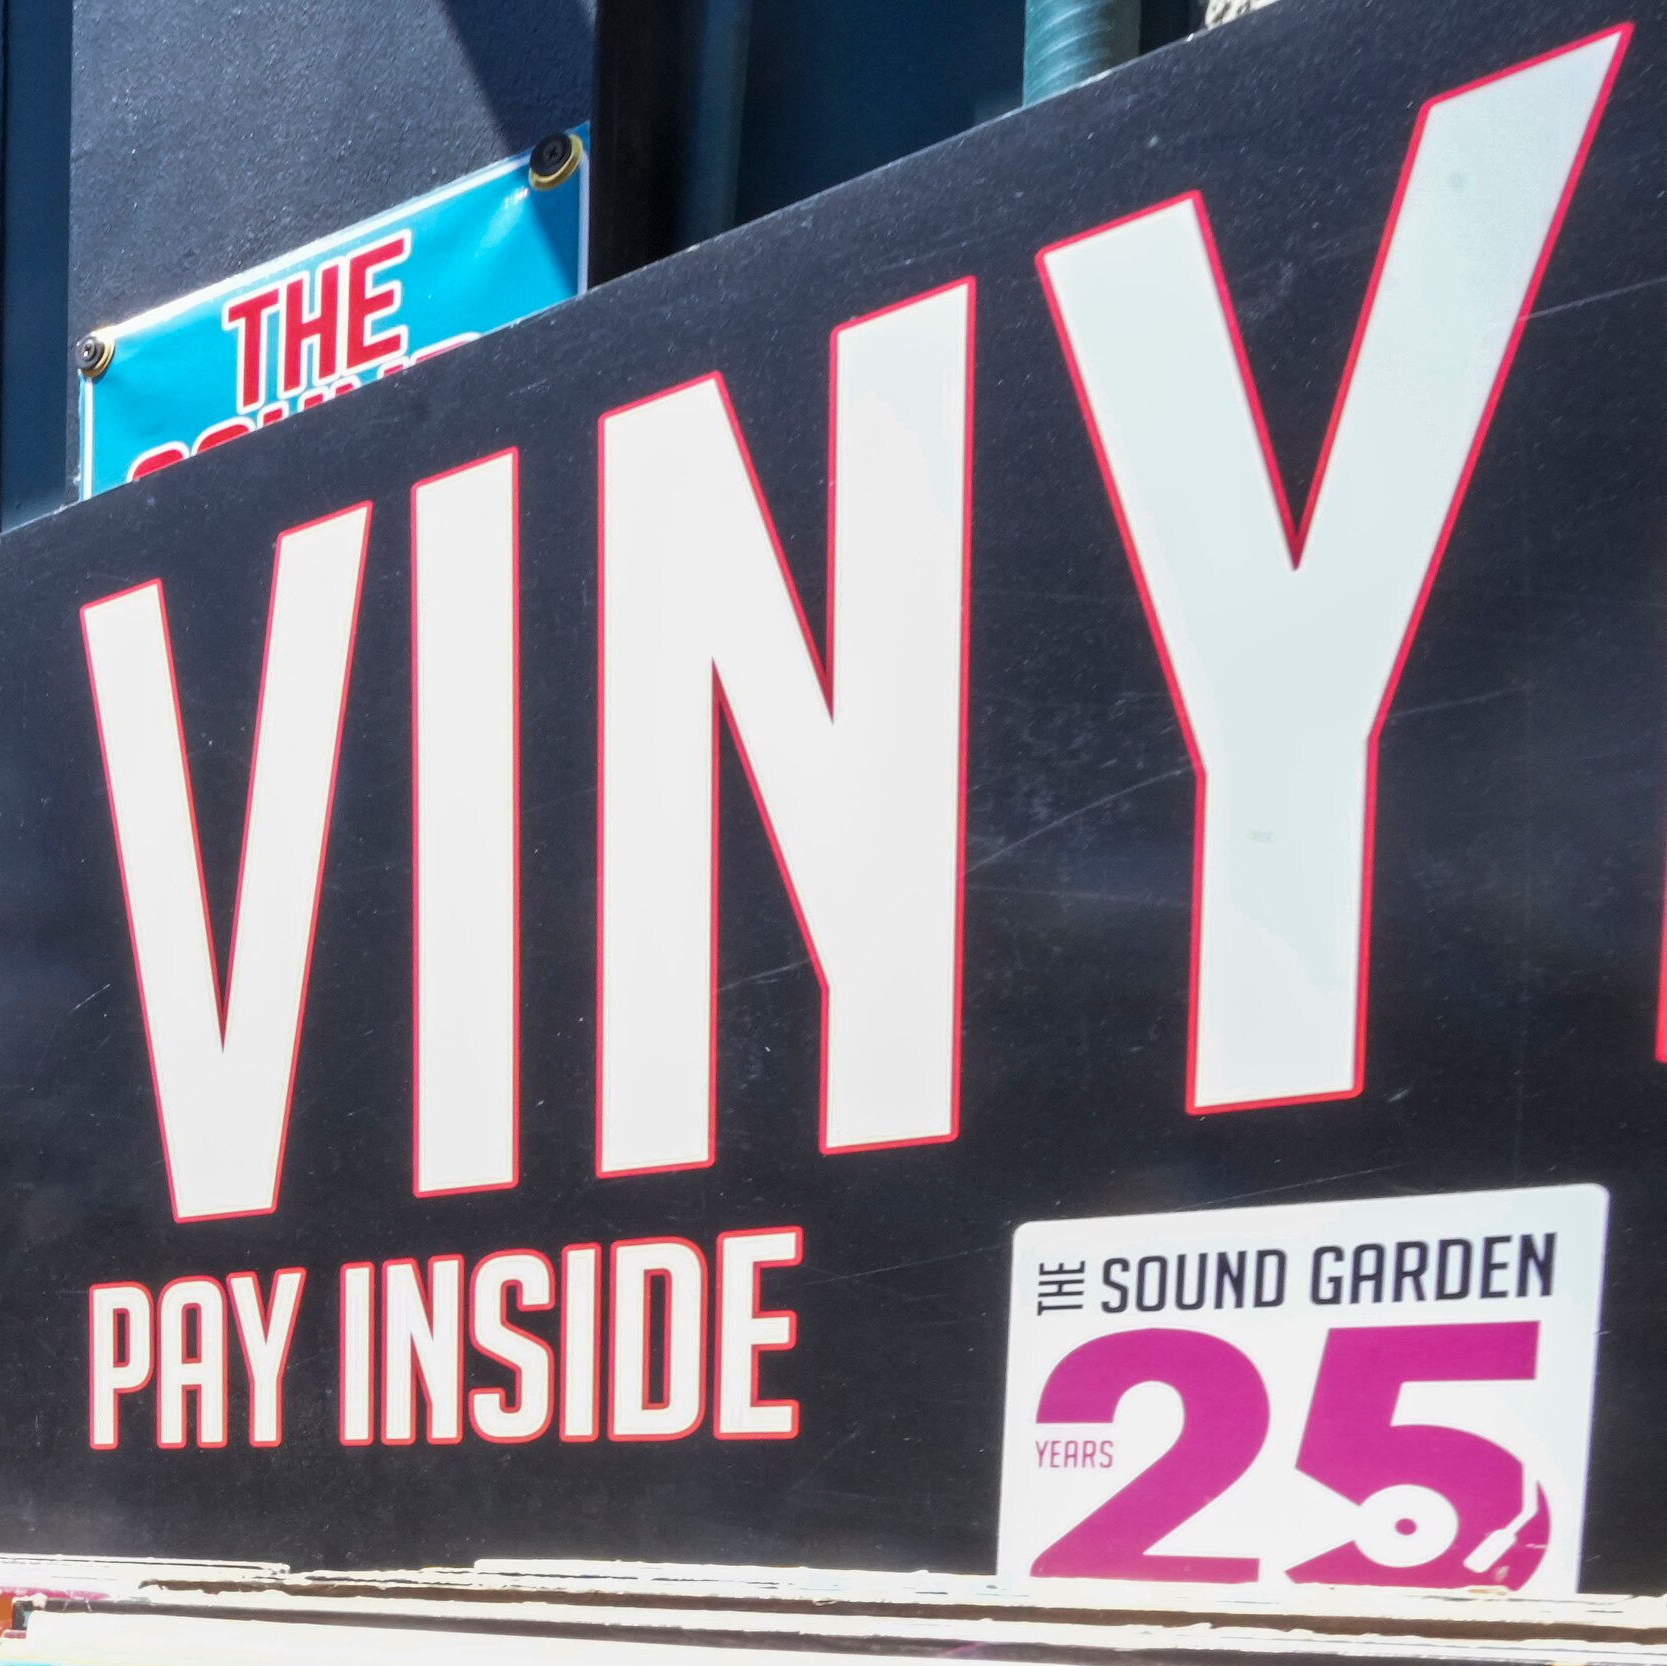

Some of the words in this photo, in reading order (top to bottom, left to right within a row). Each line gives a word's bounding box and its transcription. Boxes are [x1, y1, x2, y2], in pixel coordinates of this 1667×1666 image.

[223, 229, 411, 415] THE
[79, 22, 1667, 1223] VINY
[89, 1267, 306, 1449] PAY
[339, 1226, 804, 1446] INSIDE
[1037, 1260, 1085, 1315] THE
[1101, 1248, 1287, 1314] SOUND
[1310, 1232, 1558, 1305] GARDEN
[1030, 1320, 1552, 1592] 25
[1035, 1440, 1114, 1468] YEARS
